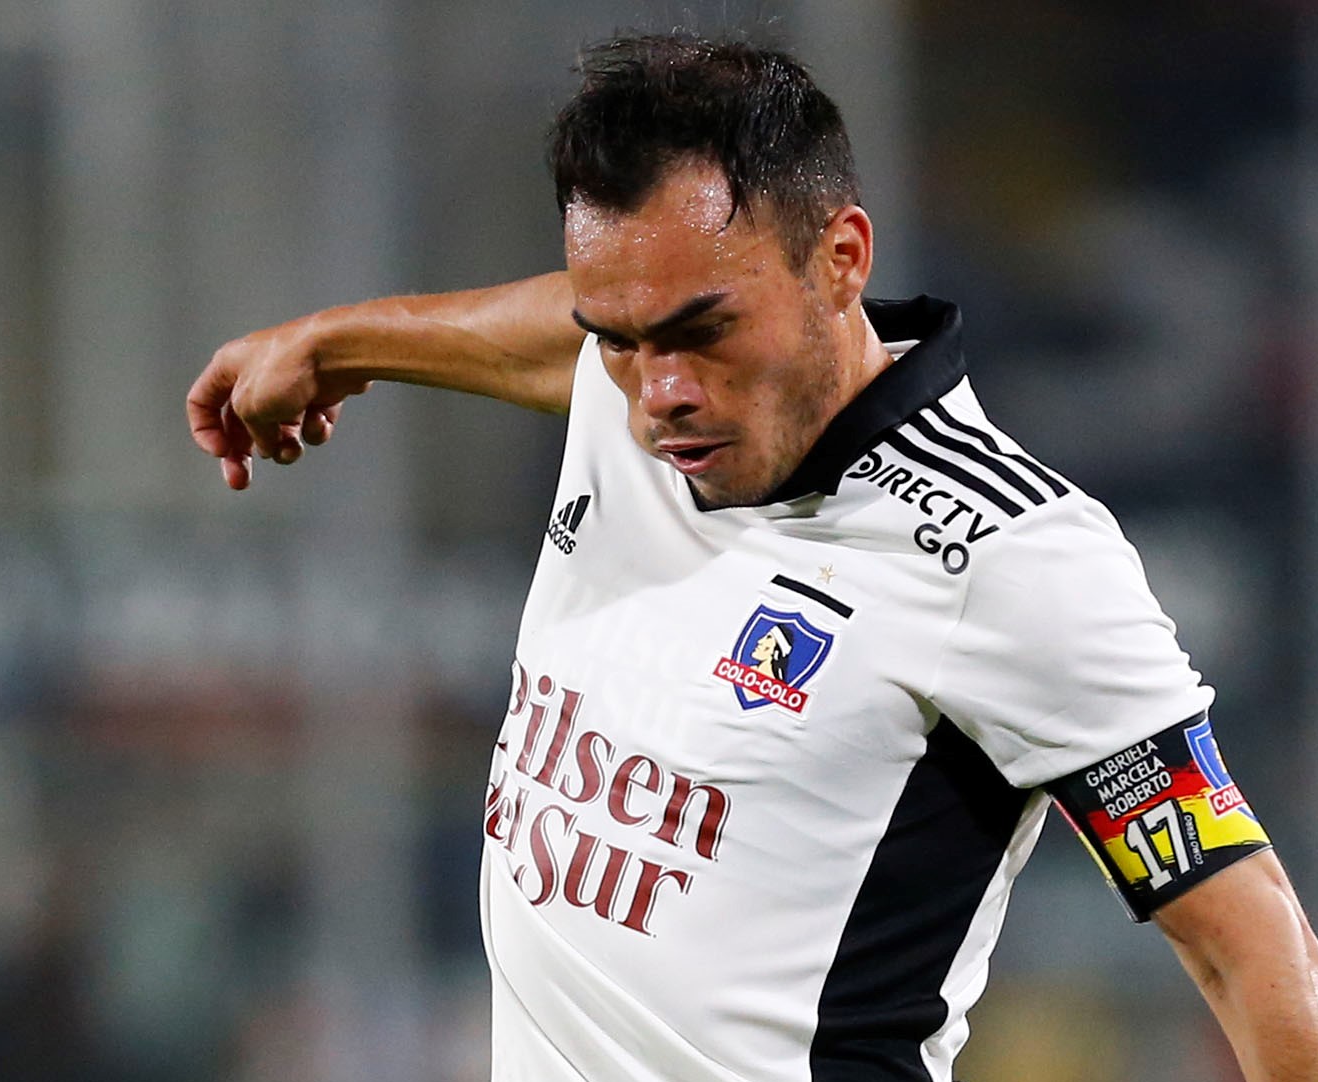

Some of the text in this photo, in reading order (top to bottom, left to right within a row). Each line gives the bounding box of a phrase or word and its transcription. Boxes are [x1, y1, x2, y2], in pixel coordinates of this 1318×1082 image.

[845, 450, 1000, 544] DIRECTV
[914, 523, 970, 575] GO
[718, 661, 802, 708] COLO-COLO
[1085, 739, 1159, 788] GABRIELA
[1097, 756, 1166, 804] MARCELA
[1105, 771, 1173, 820] ROBERTO
[1125, 799, 1191, 891] 17
[514, 804, 693, 938] Sur
